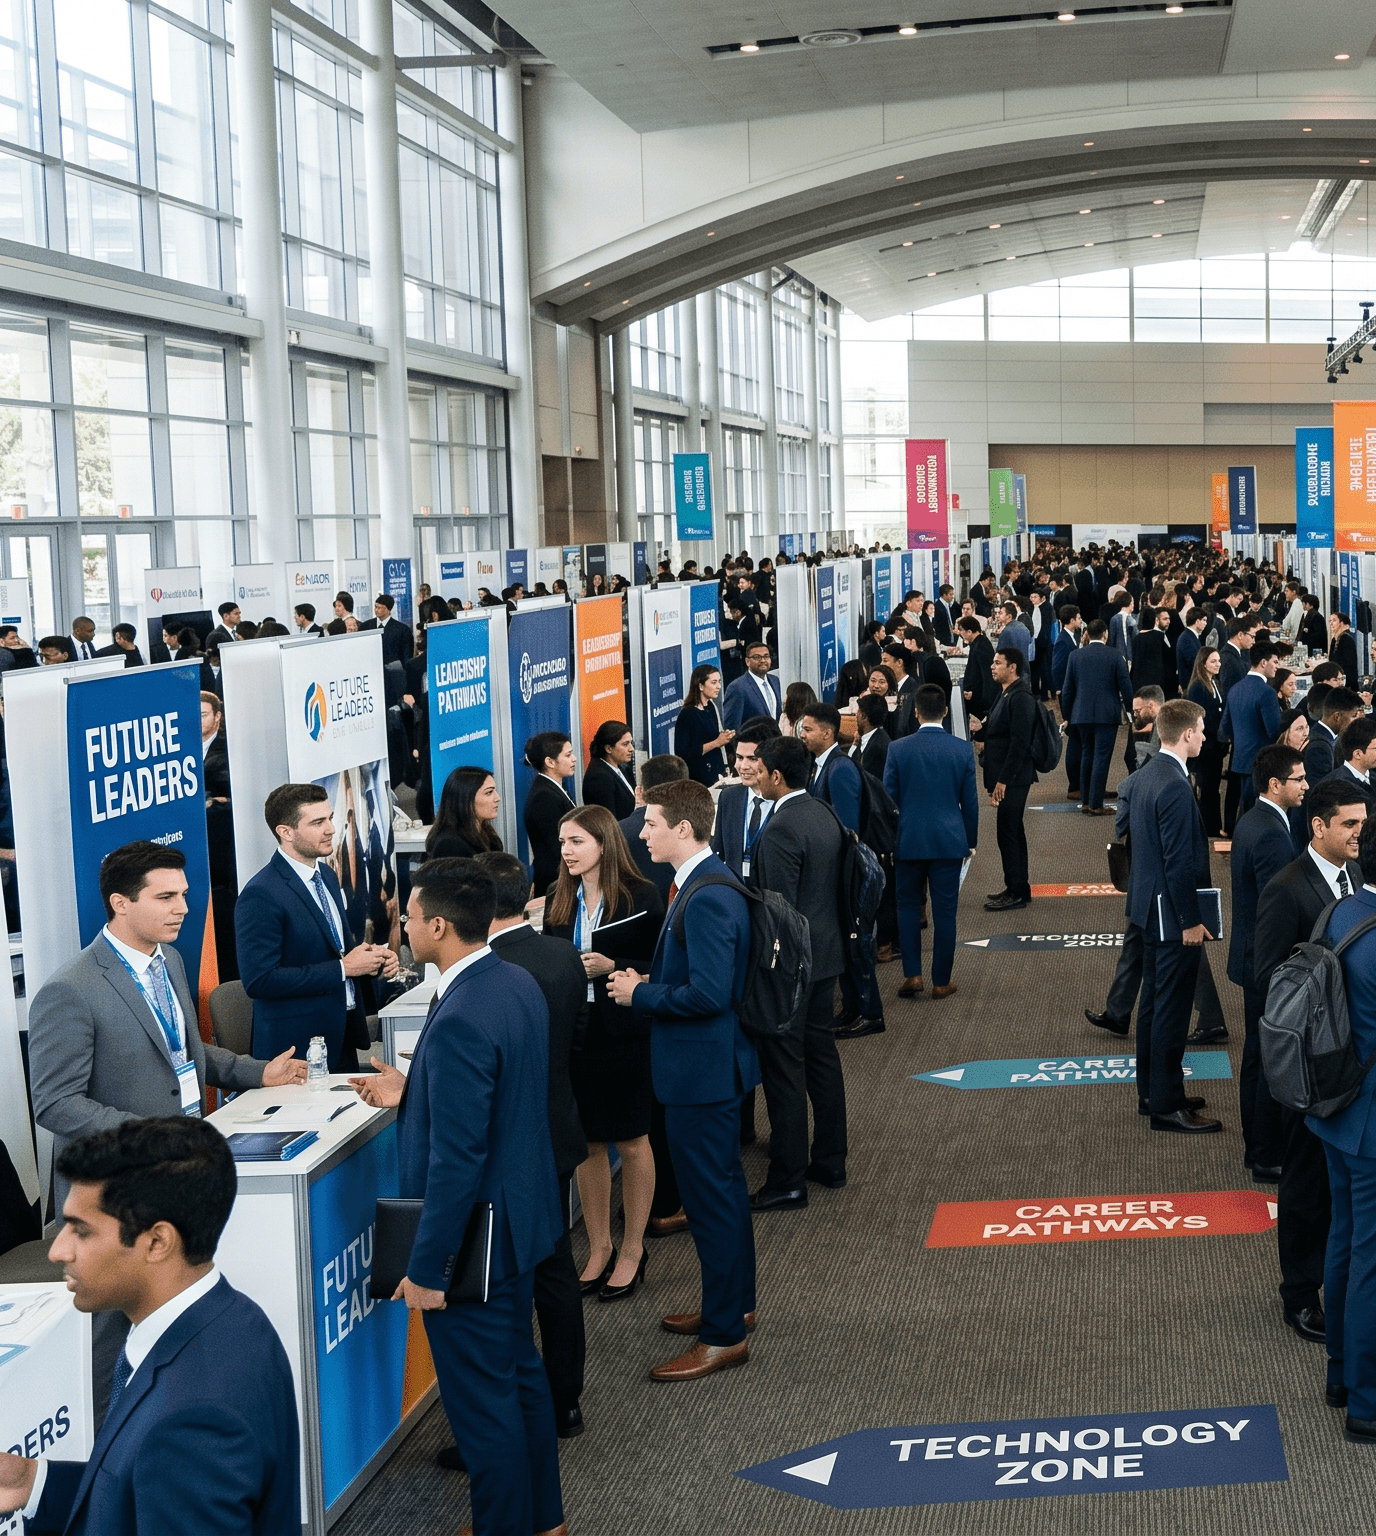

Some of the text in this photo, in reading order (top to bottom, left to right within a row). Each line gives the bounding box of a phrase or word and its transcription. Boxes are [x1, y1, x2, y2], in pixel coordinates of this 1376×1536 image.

[329, 674, 370, 701] FUTURE
[331, 696, 374, 722] LEADERS
[85, 711, 181, 773] FUTURE
[88, 755, 199, 824] LEADERS
[1016, 933, 1125, 942] TECHNO
[1010, 1066, 1194, 1083] PATHWS
[1037, 1058, 1137, 1071] CARE
[1014, 1200, 1175, 1220] CAREER
[981, 1216, 1209, 1239] PATHWAYS
[322, 1221, 376, 1307] FUTU
[324, 1274, 382, 1355] LEAD
[889, 1418, 1251, 1463] TECHNOLOGY
[993, 1453, 1145, 1486] ZONE
